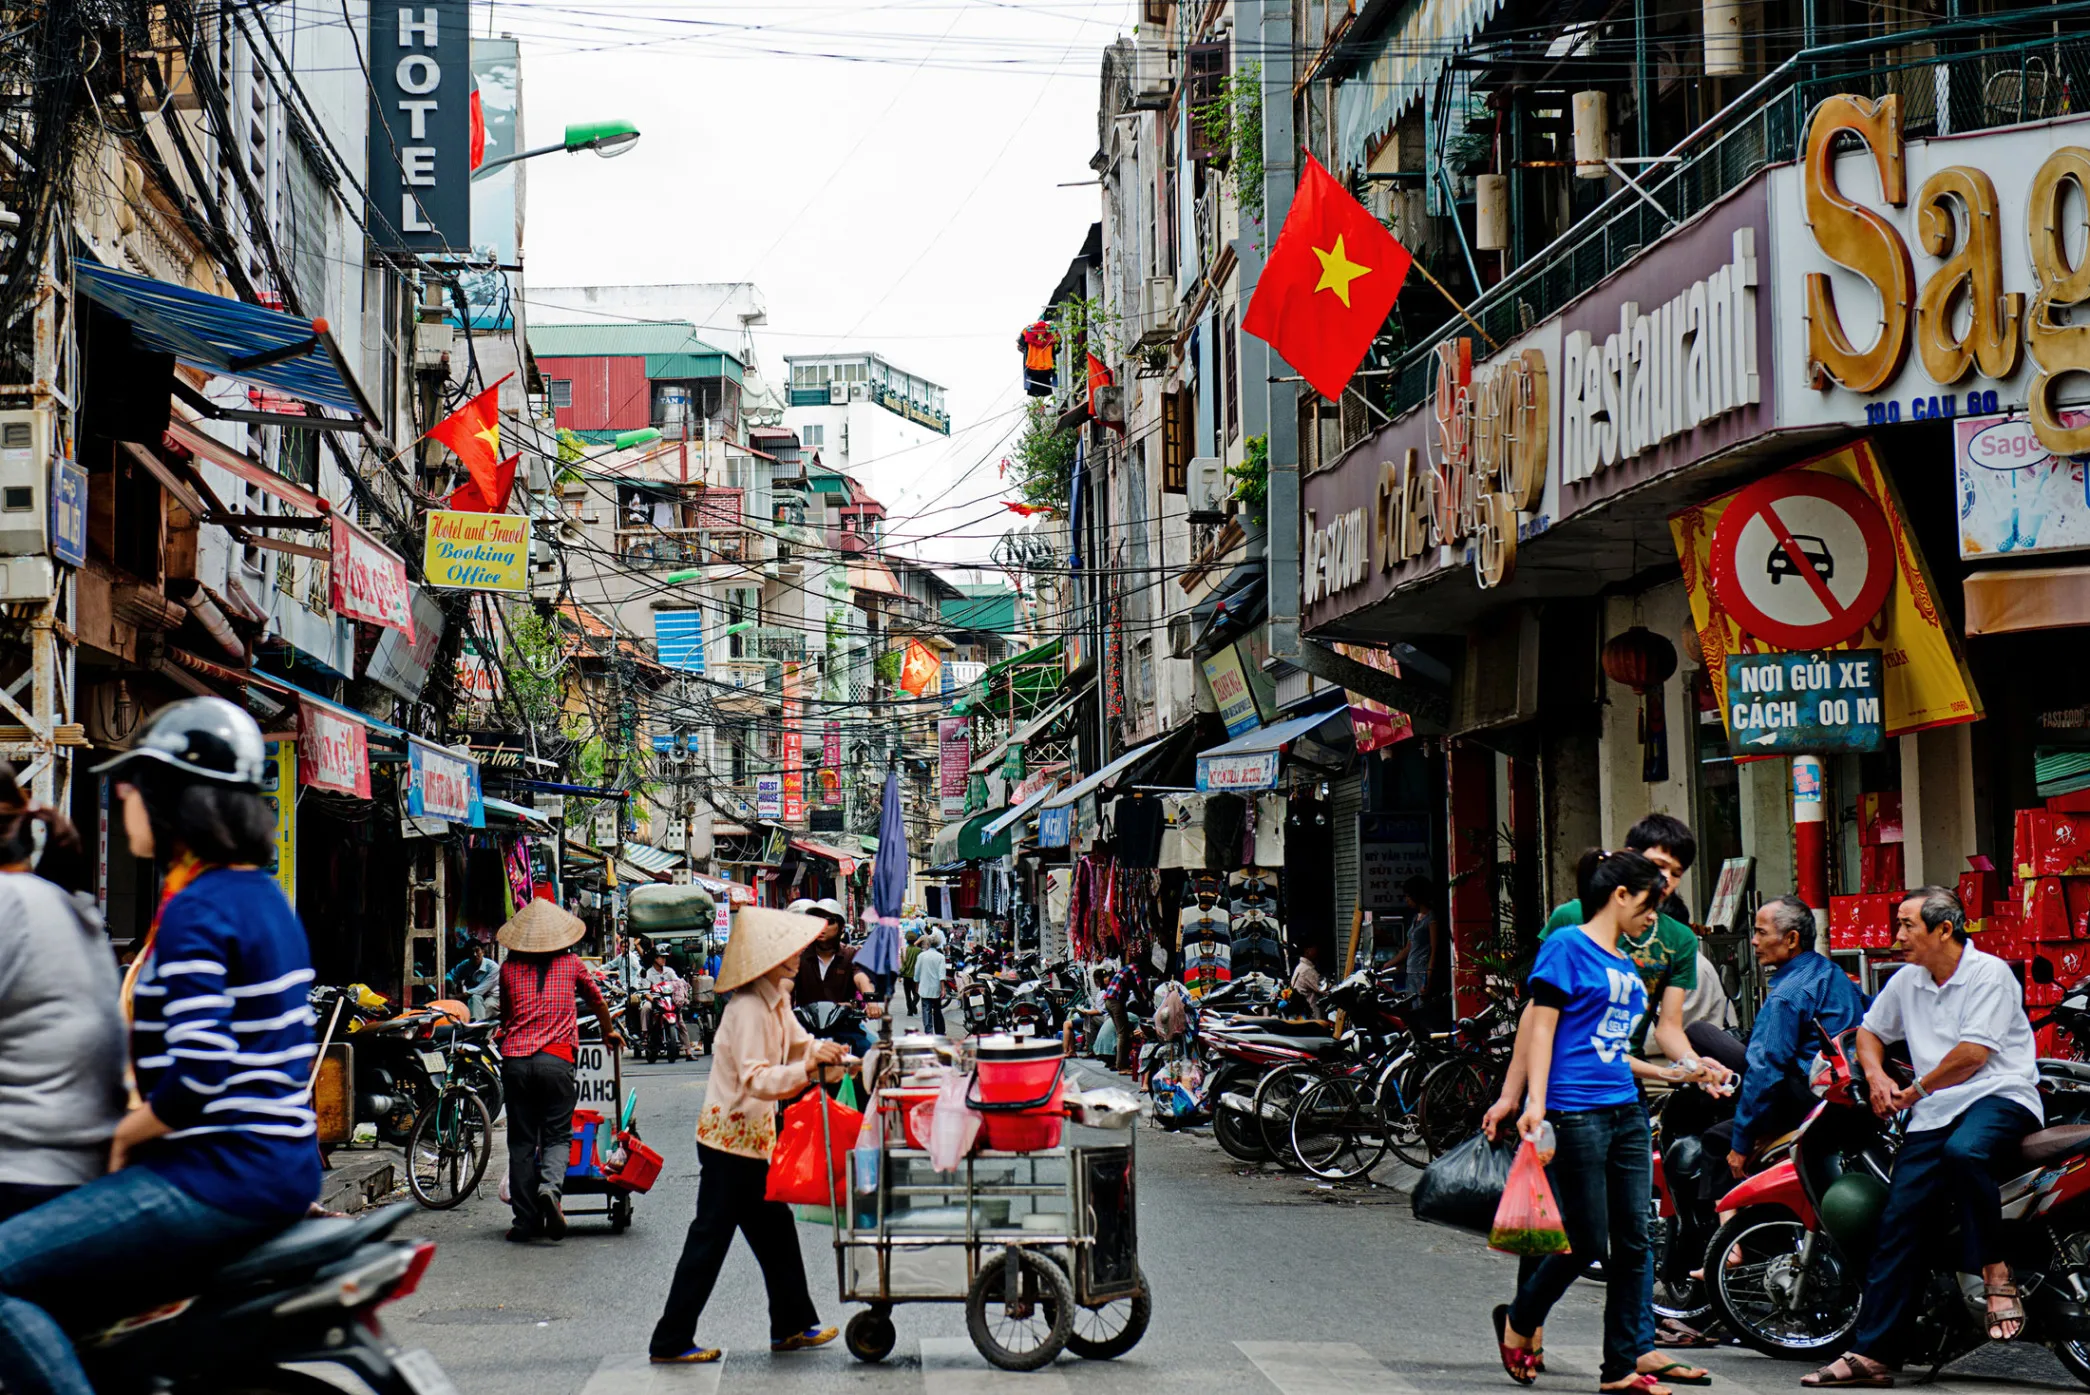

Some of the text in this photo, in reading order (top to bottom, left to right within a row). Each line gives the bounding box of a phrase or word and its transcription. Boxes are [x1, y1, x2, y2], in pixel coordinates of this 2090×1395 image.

[396, 6, 441, 233] HOTEL
[1562, 227, 1760, 486] Restaurant
[1864, 389, 1998, 425] 100 CAU GO
[431, 515, 526, 544] Hotel and Travel
[436, 542, 515, 566] Booking
[447, 564, 501, 585] Office
[1741, 654, 1870, 693] NƠI GỬI XE
[1732, 696, 1797, 730] CÁCH
[1857, 697, 1880, 724] M
[491, 741, 521, 767] Inn
[758, 781, 778, 791] GUEST
